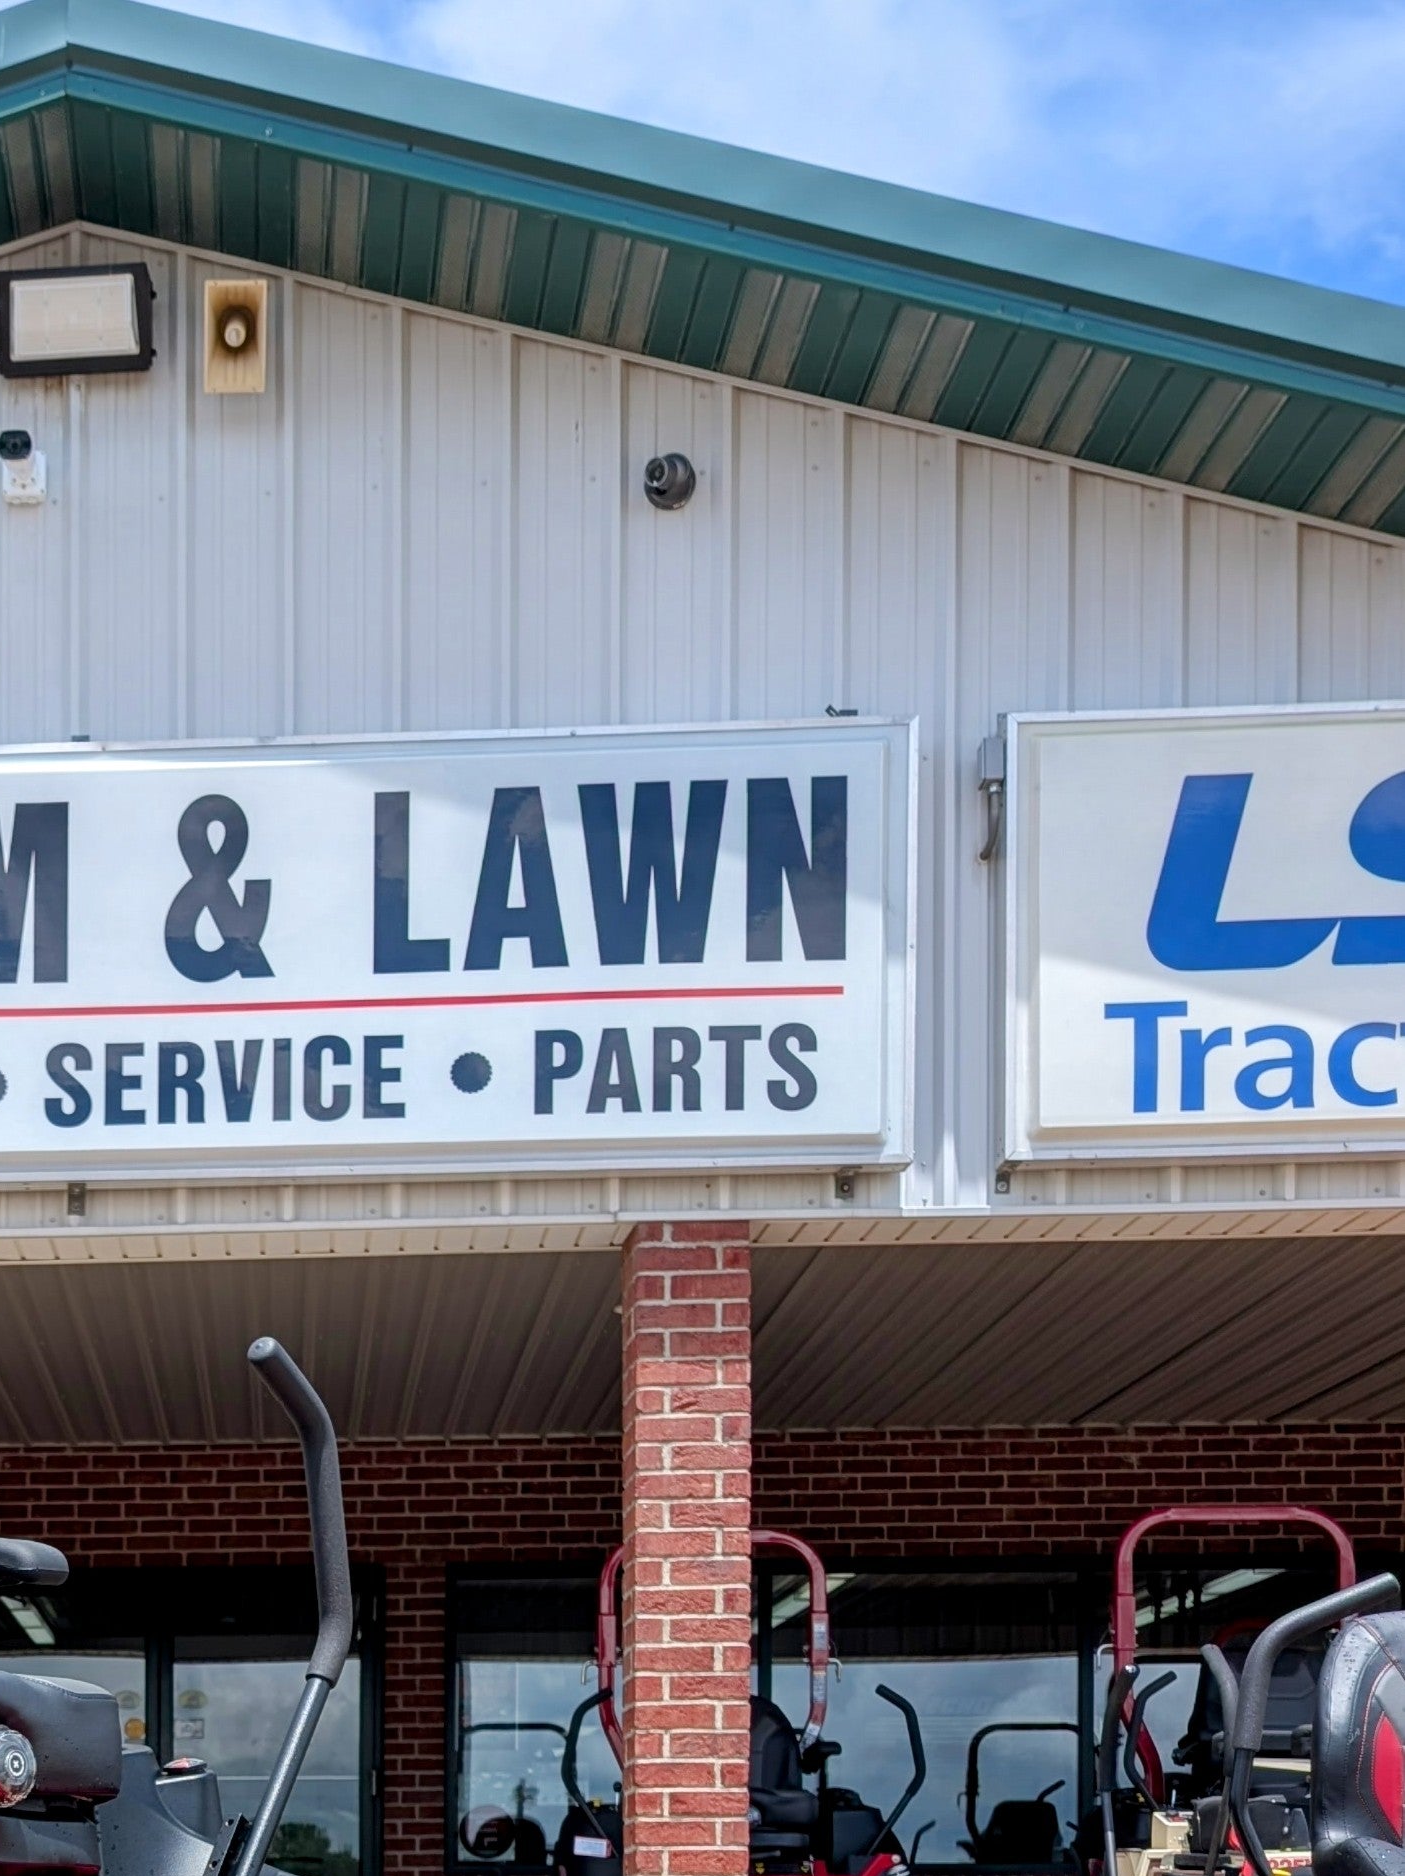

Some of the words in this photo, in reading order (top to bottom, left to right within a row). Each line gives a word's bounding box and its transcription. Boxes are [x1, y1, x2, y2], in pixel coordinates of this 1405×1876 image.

[165, 794, 275, 983] &
[373, 775, 848, 974] LAWN
[44, 1034, 406, 1128] SERVICE
[534, 1022, 818, 1115] PARTS
[1104, 1000, 1405, 1114] Trac
